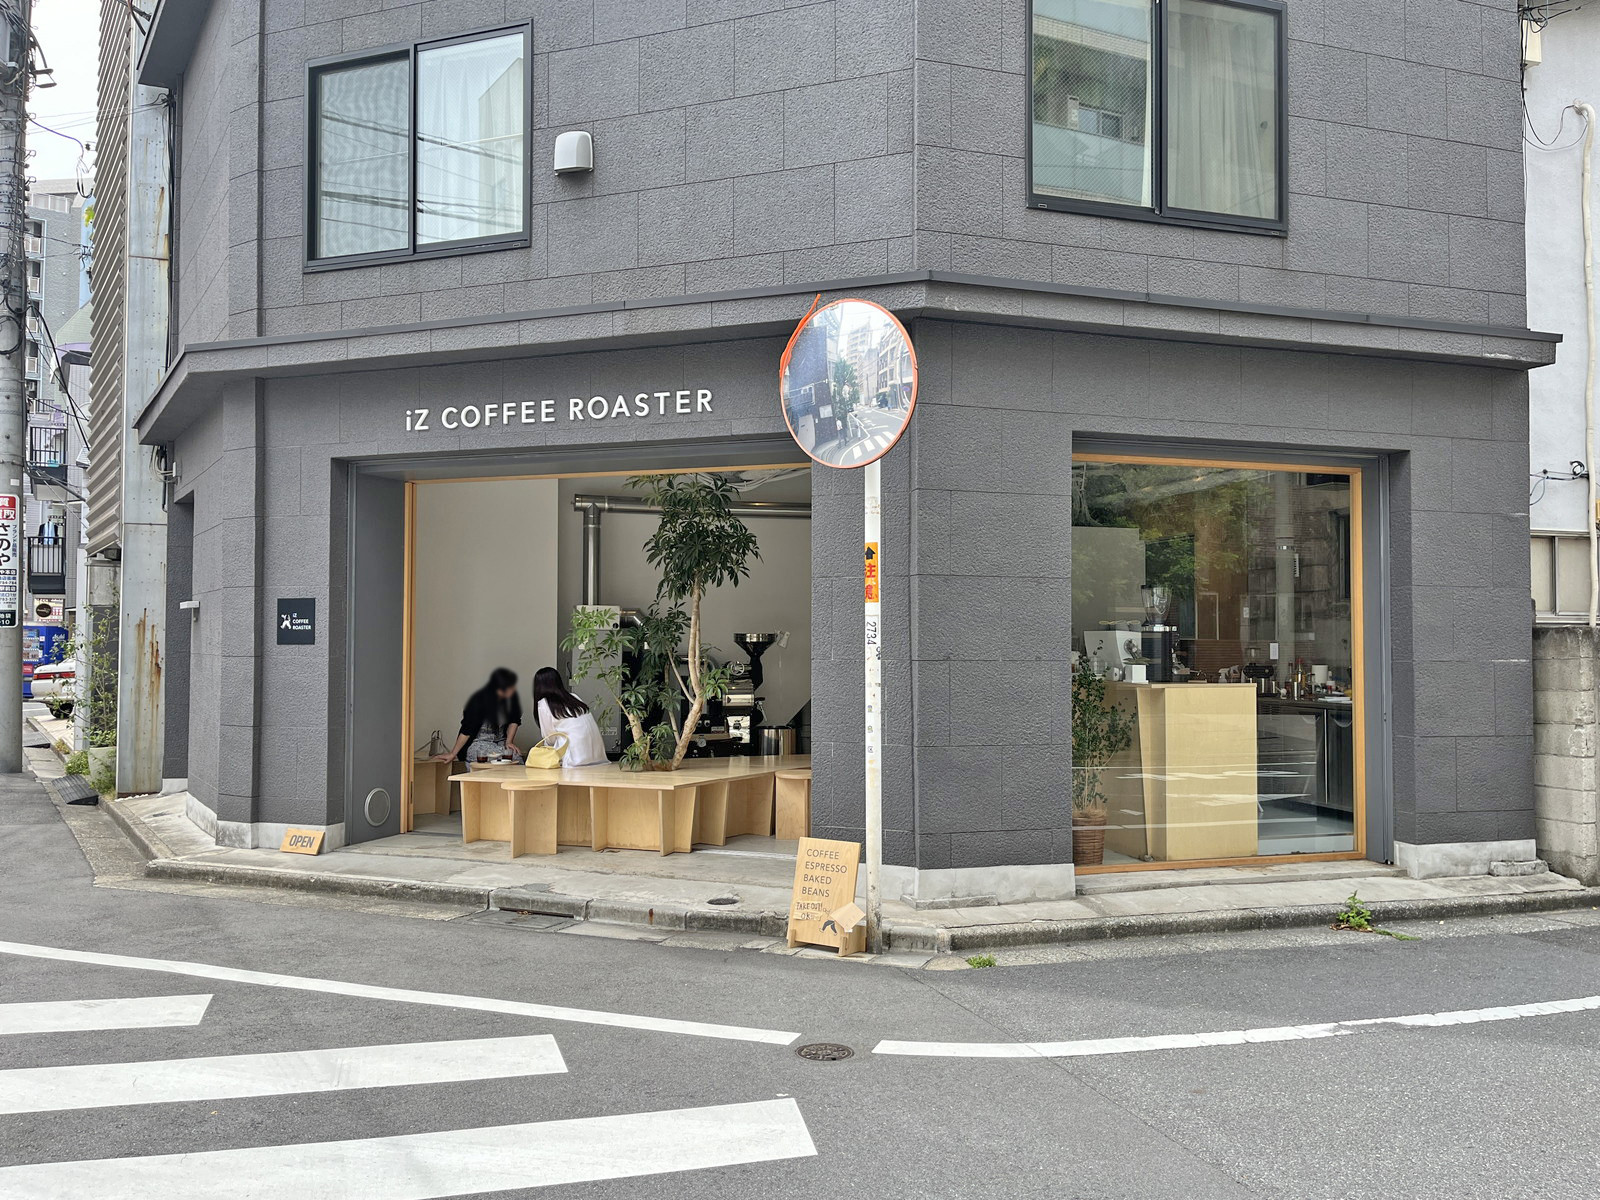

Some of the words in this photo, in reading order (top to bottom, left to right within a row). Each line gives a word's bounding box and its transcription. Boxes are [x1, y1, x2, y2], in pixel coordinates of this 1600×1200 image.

[405, 408, 430, 431] iZ
[441, 400, 556, 430] COFFEE
[568, 389, 714, 421] ROASTER
[866, 621, 877, 646] 2734
[289, 834, 315, 848] OPEN
[806, 848, 840, 860] COFFEE
[805, 861, 848, 873] ESPRESSO
[803, 874, 832, 885] BAKED
[801, 886, 830, 898] BEANS
